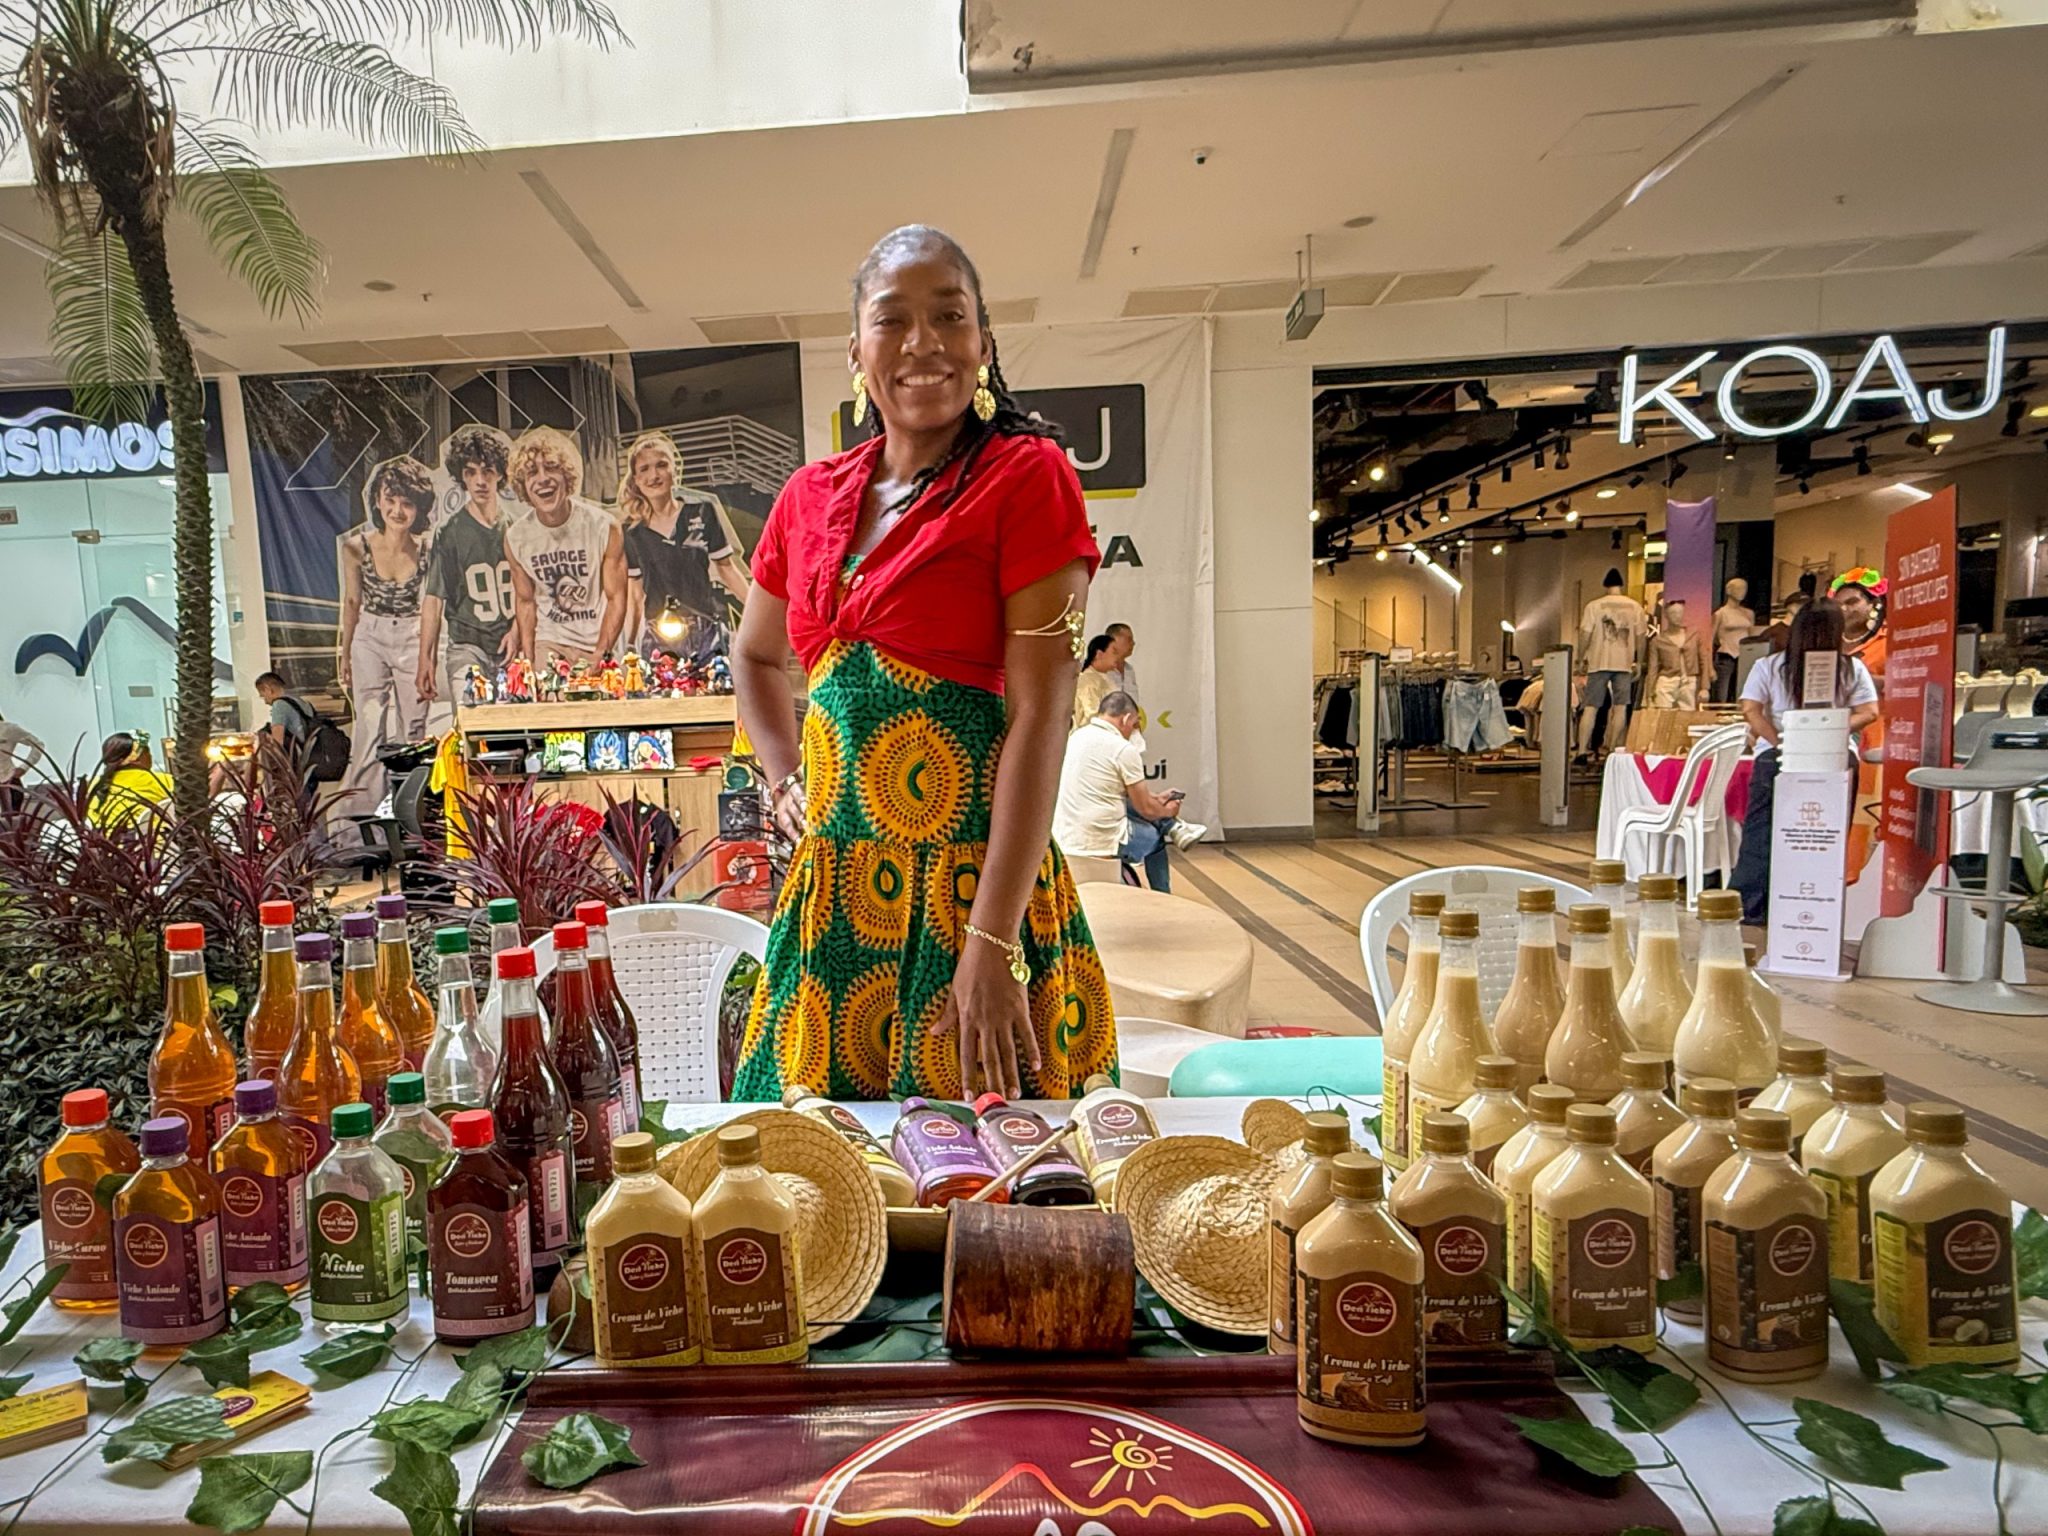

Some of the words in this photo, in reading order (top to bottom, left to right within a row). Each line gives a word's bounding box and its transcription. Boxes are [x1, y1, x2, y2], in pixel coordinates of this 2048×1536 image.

[1618, 326, 2007, 444] KOAJ
[531, 549, 587, 567] SAVAGE
[48, 1239, 73, 1251] Viche
[320, 1252, 365, 1272] Viche
[445, 1272, 498, 1285] Tomaseca
[122, 1282, 143, 1294] Viche
[145, 1283, 181, 1294] Anisado
[1572, 1288, 1605, 1299] Crema
[1607, 1288, 1620, 1299] de
[1622, 1286, 1648, 1298] Viche
[1971, 1286, 1985, 1298] de
[711, 1305, 741, 1316] Crema
[743, 1302, 755, 1314] de
[757, 1299, 783, 1313] Viche
[1458, 1295, 1470, 1306] de
[1473, 1295, 1500, 1306] Viche
[1760, 1301, 1790, 1312] Crema
[1792, 1296, 1803, 1307] de
[611, 1312, 642, 1323] Crema
[644, 1309, 656, 1321] de
[658, 1304, 684, 1318] Viche
[1323, 1354, 1360, 1369] Crema
[1363, 1358, 1377, 1370] de
[1381, 1359, 1411, 1371] Viche
